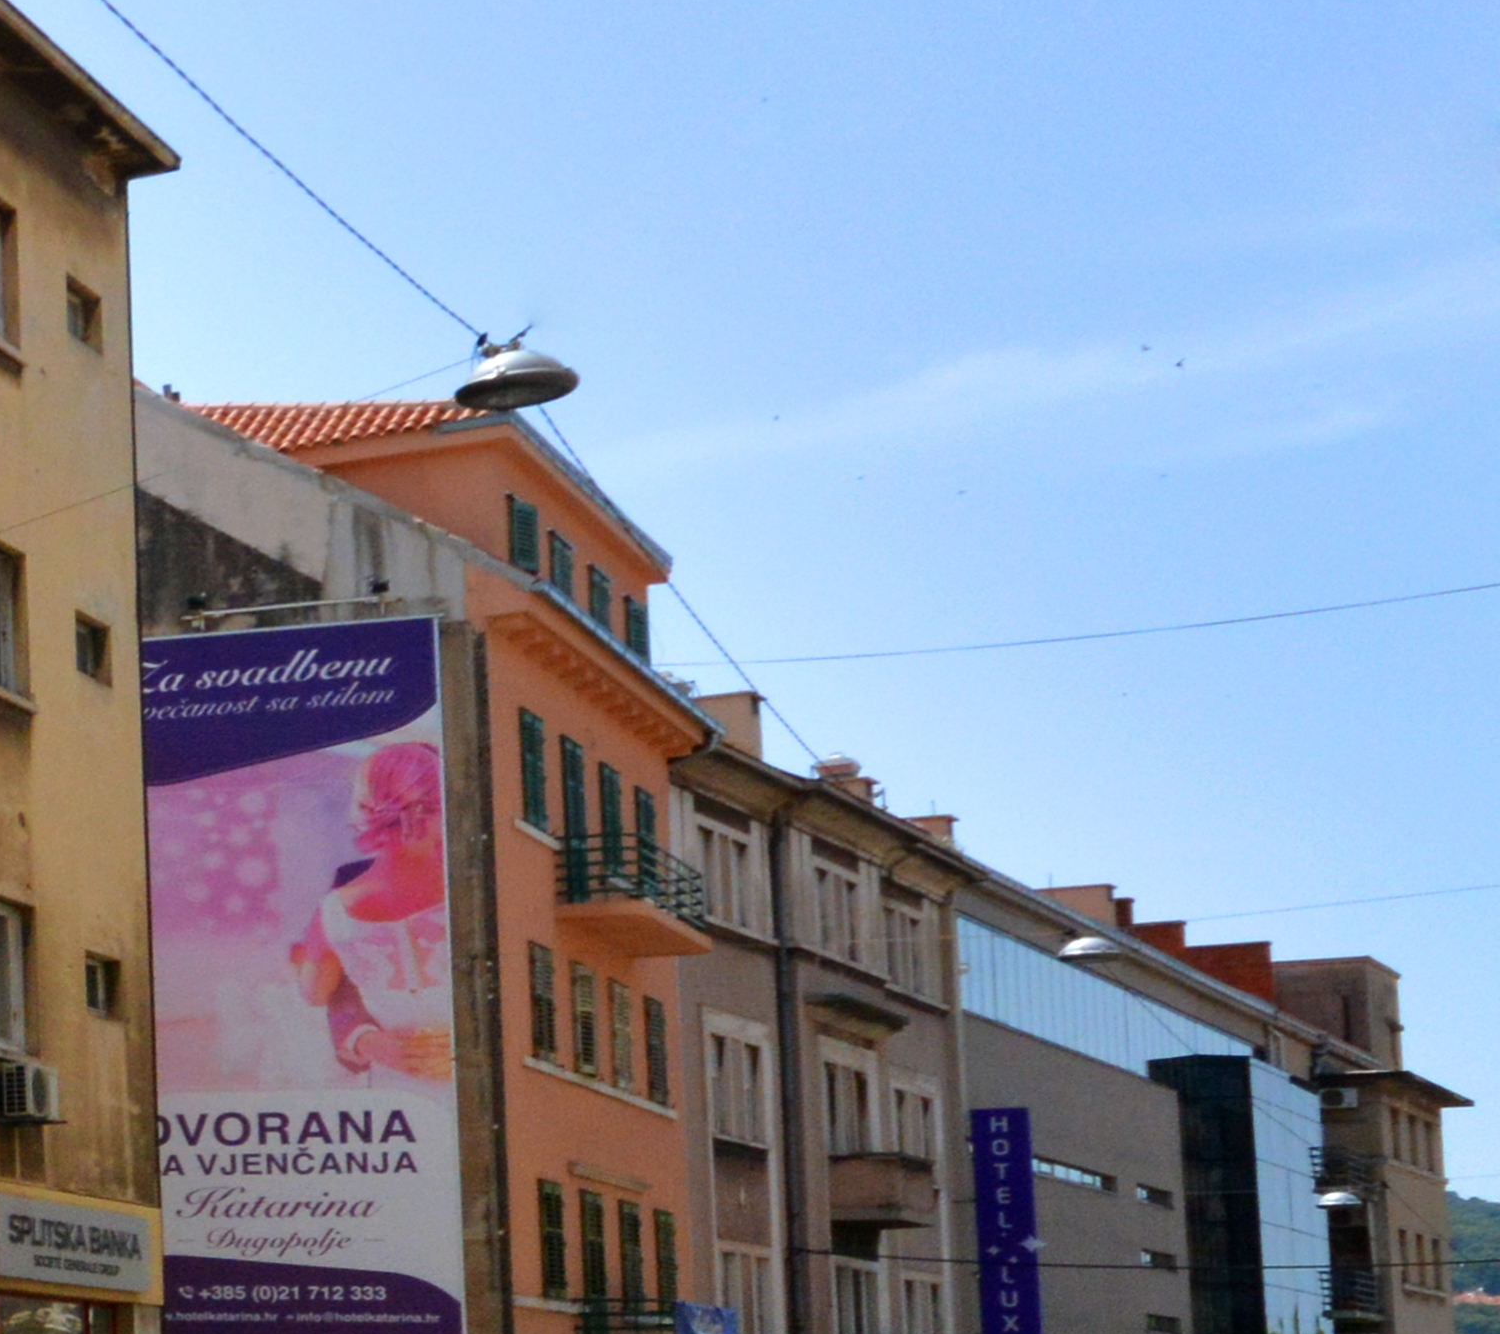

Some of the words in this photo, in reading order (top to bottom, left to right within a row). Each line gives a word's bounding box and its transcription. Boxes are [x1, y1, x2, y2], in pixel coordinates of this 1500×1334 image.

[142, 660, 184, 693] Za
[195, 649, 393, 689] svadbenu
[265, 696, 299, 711] sa
[307, 680, 395, 709] stilom
[160, 1154, 185, 1176] A
[197, 1147, 419, 1176] VJENČANJA
[990, 1115, 1013, 1229] HOTEL
[175, 1186, 384, 1218] Katarina
[8, 1214, 88, 1252] SPLITSKA
[88, 1226, 143, 1260] BANKA
[206, 1227, 352, 1257] Dugopolje
[198, 1285, 246, 1300] +385
[252, 1284, 300, 1304] (0)21
[307, 1285, 344, 1300] 712
[349, 1285, 387, 1301] 333
